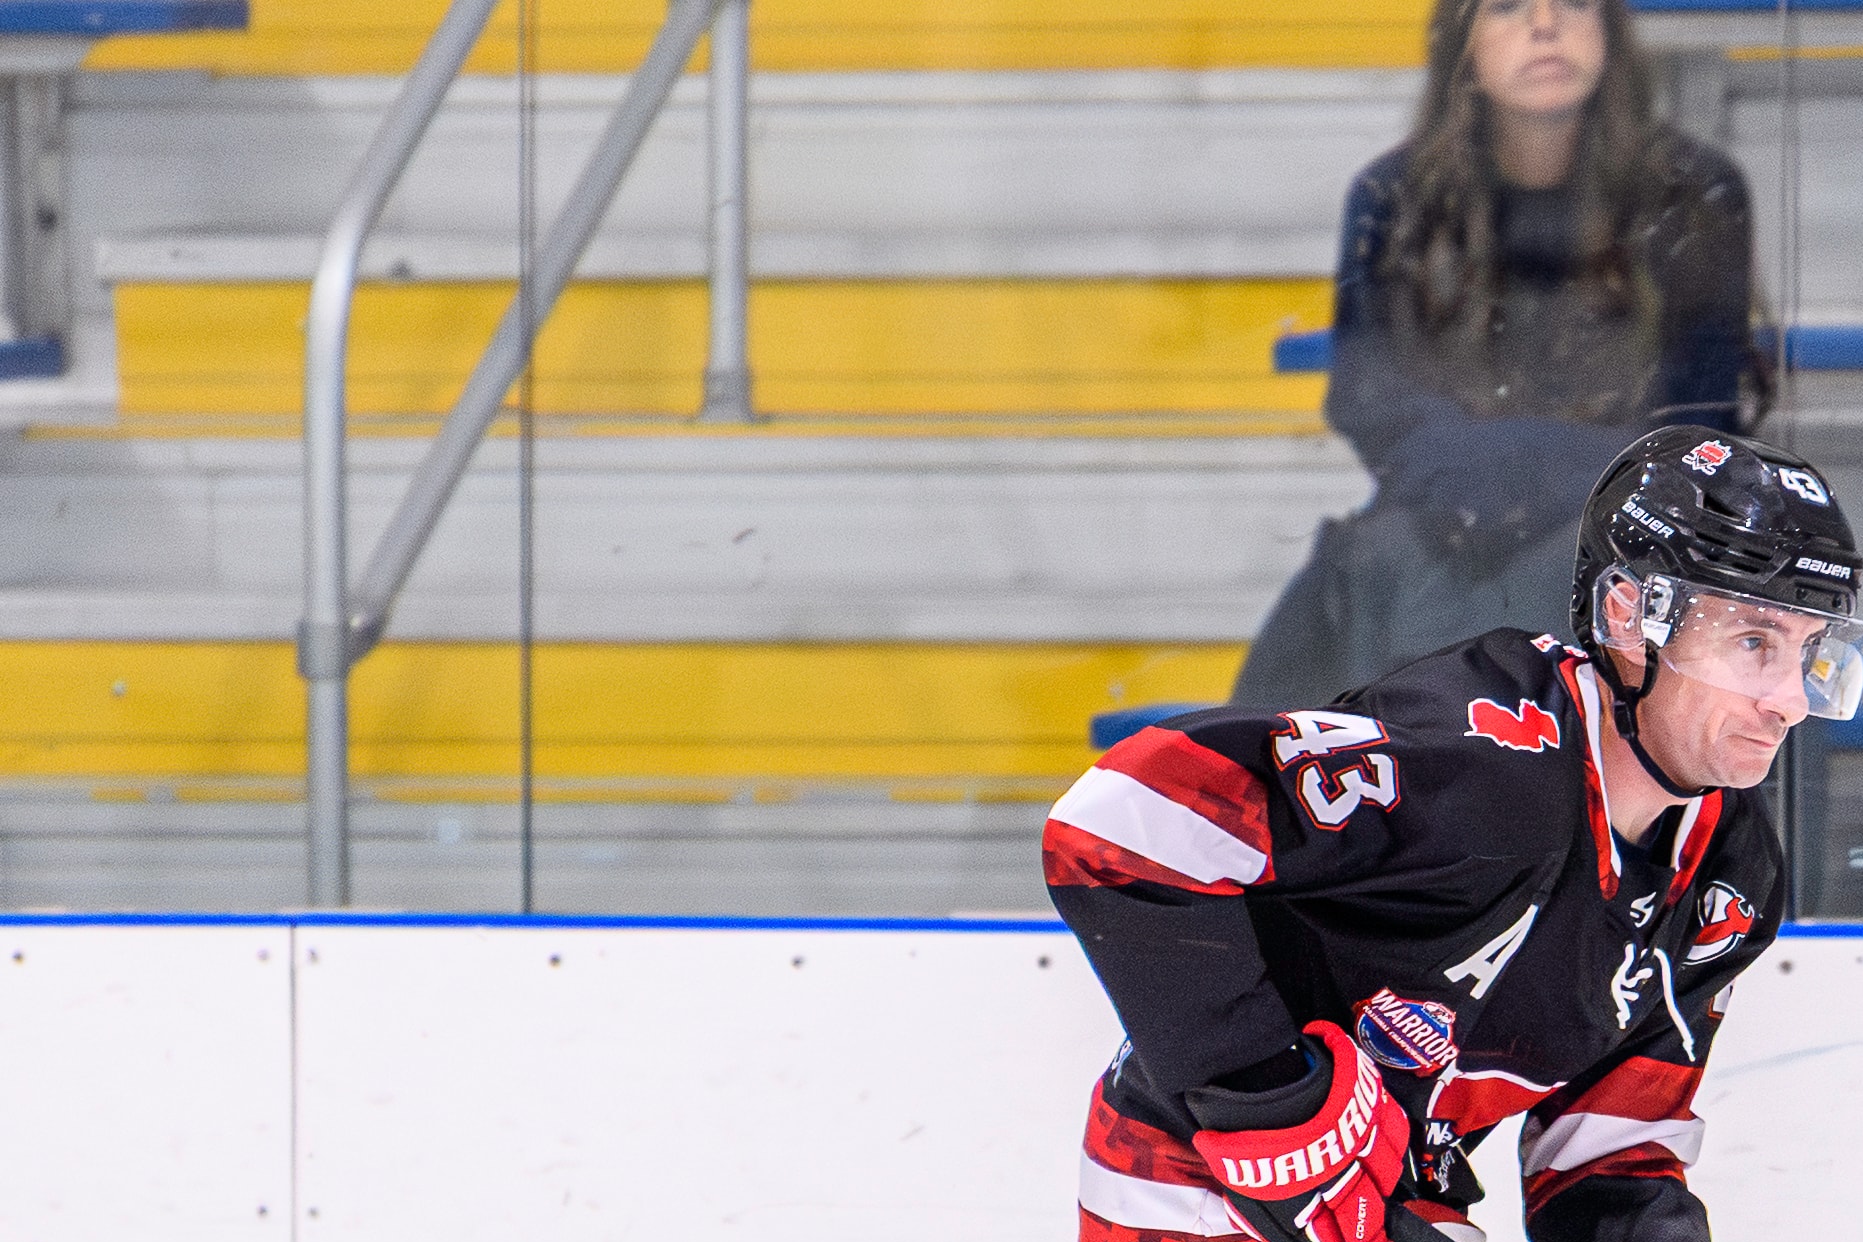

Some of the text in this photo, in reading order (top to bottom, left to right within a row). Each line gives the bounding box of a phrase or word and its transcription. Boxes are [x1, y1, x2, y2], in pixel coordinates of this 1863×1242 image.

[1778, 467, 1829, 506] 43
[1621, 501, 1675, 539] BAUER
[1796, 557, 1851, 579] BAUER
[1275, 711, 1399, 831] 43
[1445, 905, 1538, 999] A
[1371, 988, 1459, 1066] WARRIOR
[1355, 1196, 1368, 1240] COVERT
